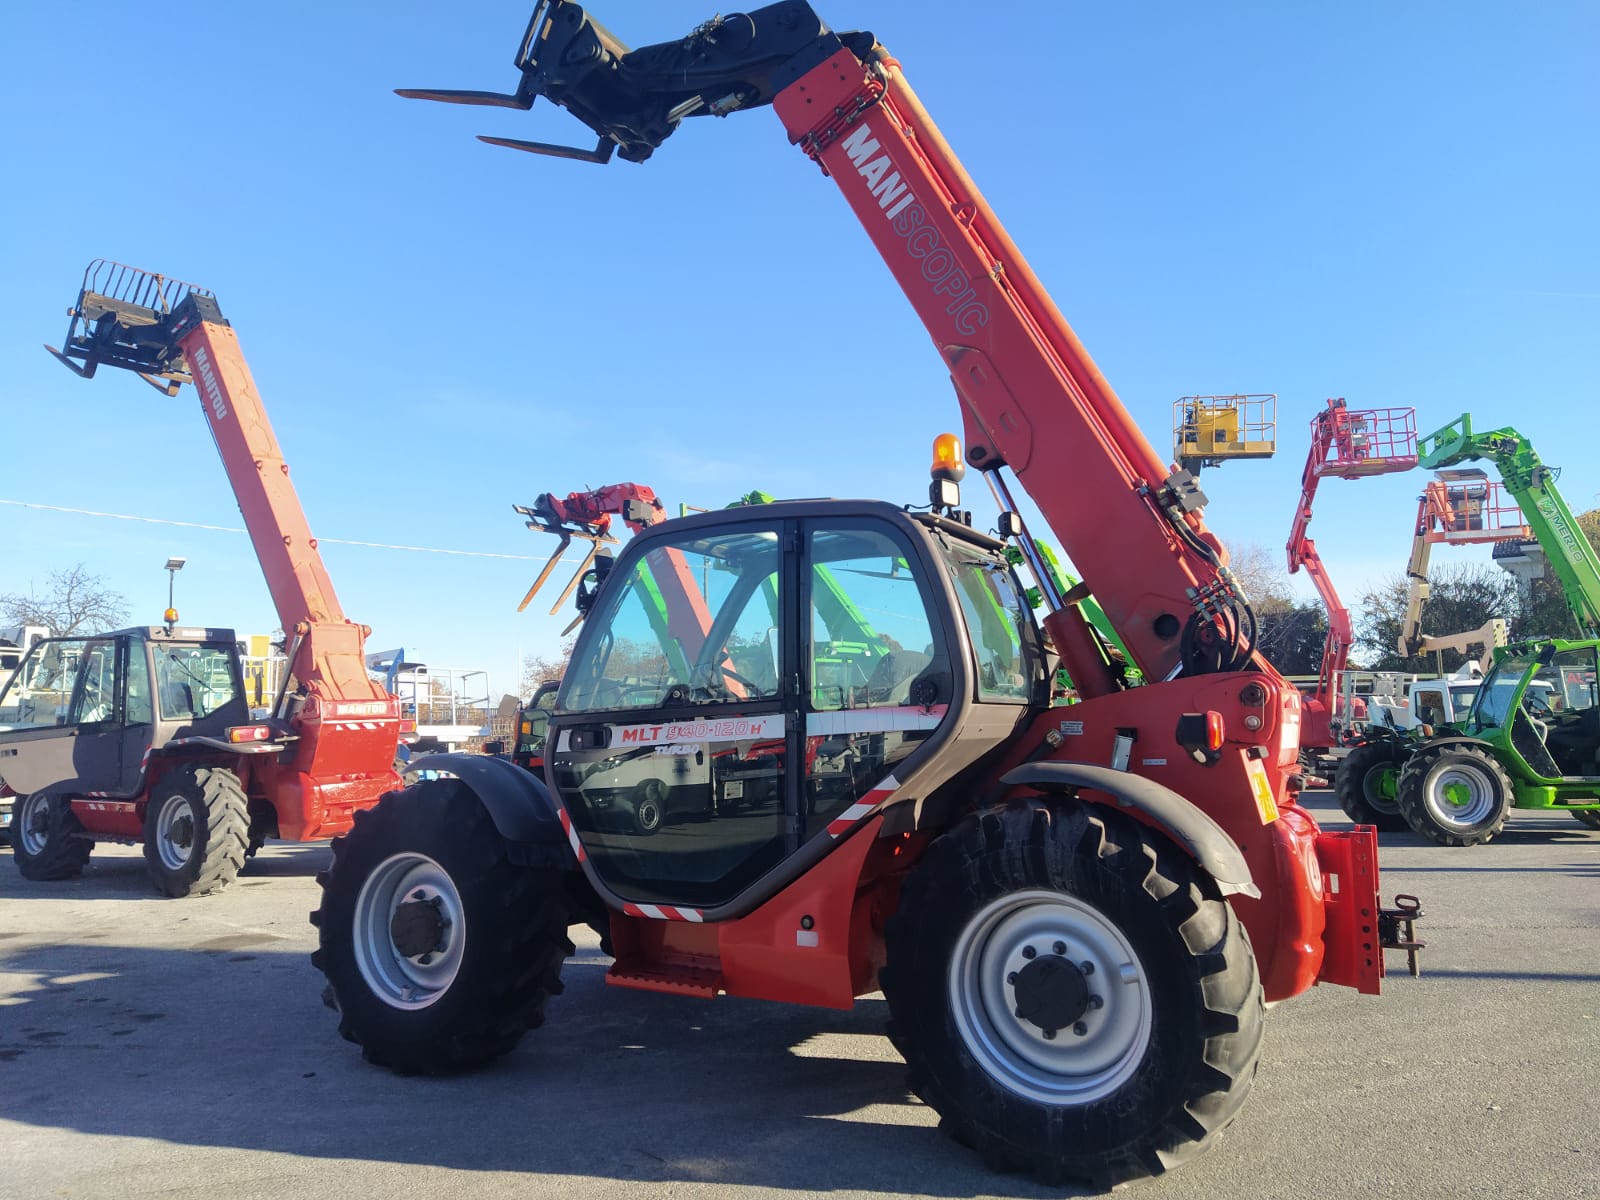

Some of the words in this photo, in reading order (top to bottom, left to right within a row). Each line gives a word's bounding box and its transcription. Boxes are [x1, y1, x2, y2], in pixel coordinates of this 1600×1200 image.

[841, 123, 989, 336] MANISCOPIC
[195, 346, 227, 420] MANITOU
[1553, 516, 1582, 561] MERLO
[622, 727, 663, 742] MLT
[654, 744, 699, 755] TURBO
